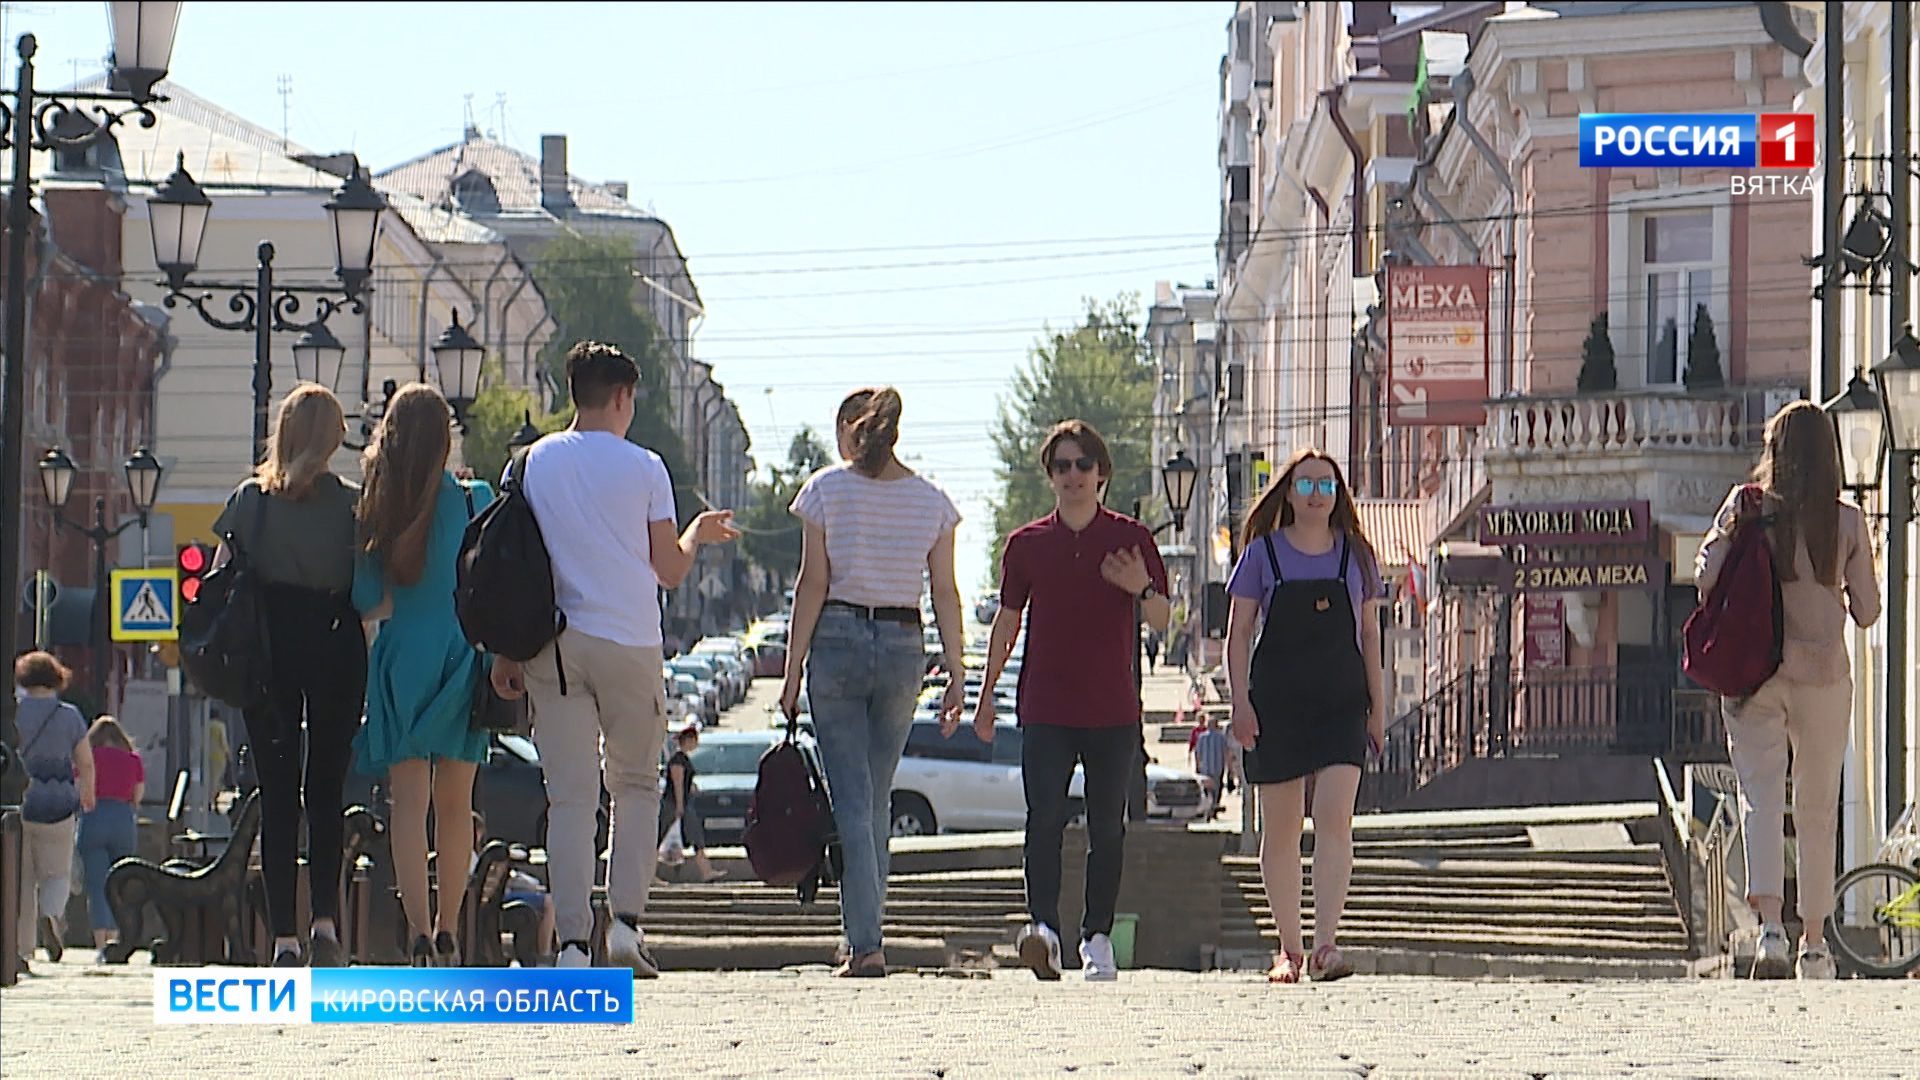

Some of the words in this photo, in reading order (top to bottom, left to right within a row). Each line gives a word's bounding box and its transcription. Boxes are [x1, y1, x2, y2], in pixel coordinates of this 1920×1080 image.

[1393, 271, 1424, 283] ДОМ
[1392, 285, 1476, 308] МЕХА
[1582, 508, 1635, 537] МОДА
[1515, 569, 1526, 588] 2
[1530, 567, 1592, 586] ЭТАЖА
[1597, 564, 1648, 584] МЕХА
